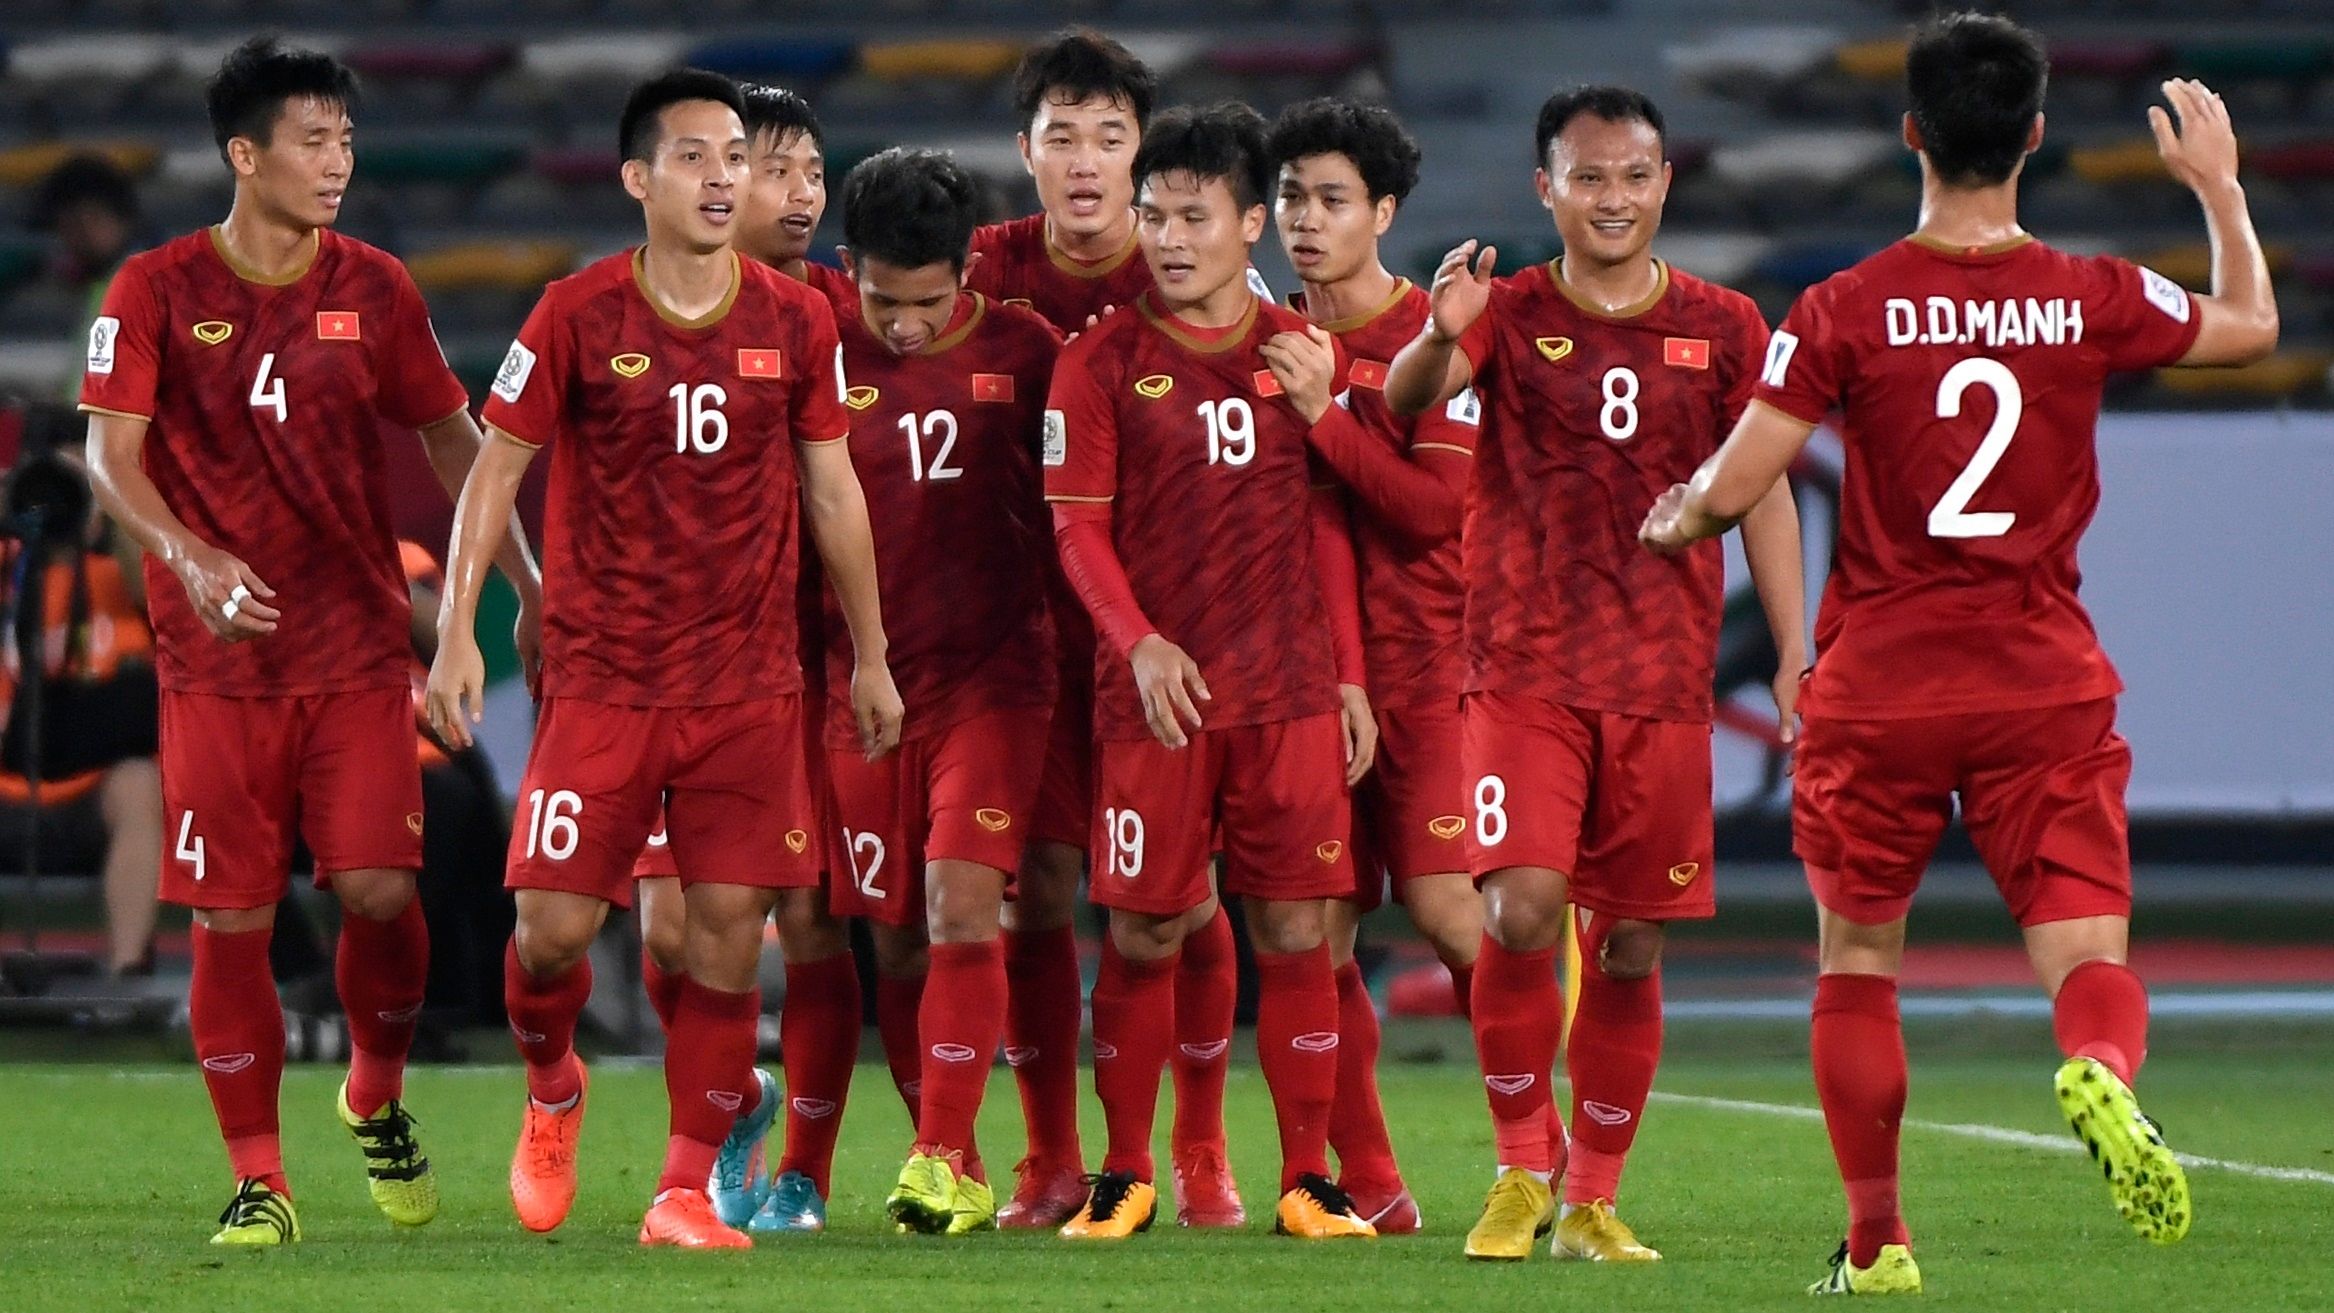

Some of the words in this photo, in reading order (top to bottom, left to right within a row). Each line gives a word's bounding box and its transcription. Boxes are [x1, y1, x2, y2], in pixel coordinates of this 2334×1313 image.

[1885, 296, 2084, 347] D.D.MANH
[249, 353, 288, 423] 4
[668, 382, 729, 454] 16
[1599, 367, 1639, 440] 8
[897, 409, 964, 482] 12
[1196, 397, 1256, 466] 19
[1927, 357, 2023, 538] 2
[175, 810, 205, 881] 4
[526, 788, 583, 861] 16
[1105, 807, 1144, 878] 19
[1474, 775, 1508, 847] 8
[843, 827, 886, 899] 12
